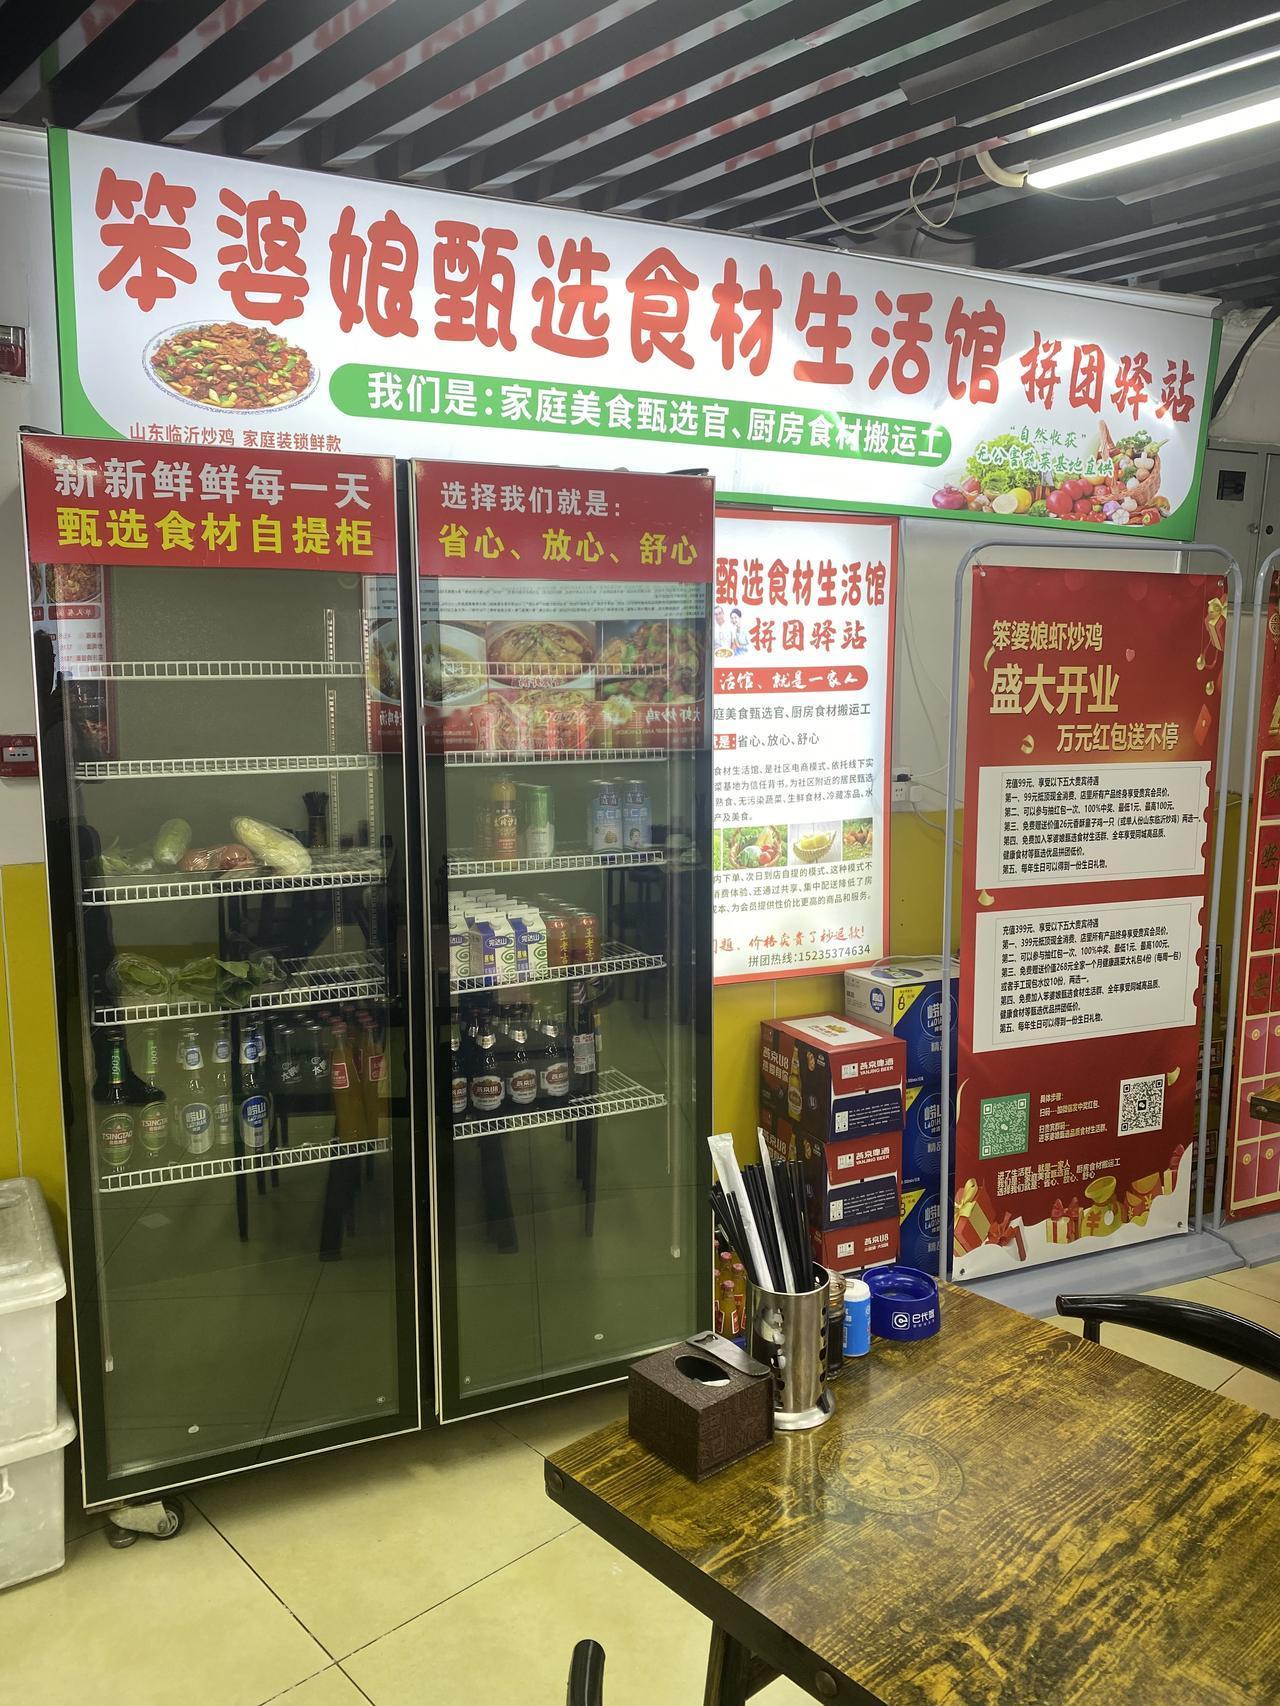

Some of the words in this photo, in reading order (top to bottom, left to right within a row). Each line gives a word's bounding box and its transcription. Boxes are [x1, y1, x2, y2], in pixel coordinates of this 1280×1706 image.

[94, 166, 1006, 405] 笨婆娘甄选食材生活馆
[1020, 329, 1197, 423] 拼团驿站
[130, 422, 235, 446] 山东临沂炒鸡
[243, 429, 342, 452] 家庭装锁鲜款
[367, 371, 943, 460] 我们是：家庭美食甄选官、厨房食材搬运工
[54, 455, 372, 510] 新新鲜鲜每一天
[977, 446, 1114, 476] 无公害蔬菜基地直供
[440, 481, 620, 517] 选择我们就是：
[56, 507, 374, 556] 甄选食材自提柜
[715, 557, 887, 607] 甄选食材生活馆
[748, 617, 868, 653] 拼团驿站
[991, 620, 1103, 652] 笨婆娘虾炒鸡
[990, 663, 1121, 716] 盛大开业
[1056, 722, 1180, 752] 万元红包送不停
